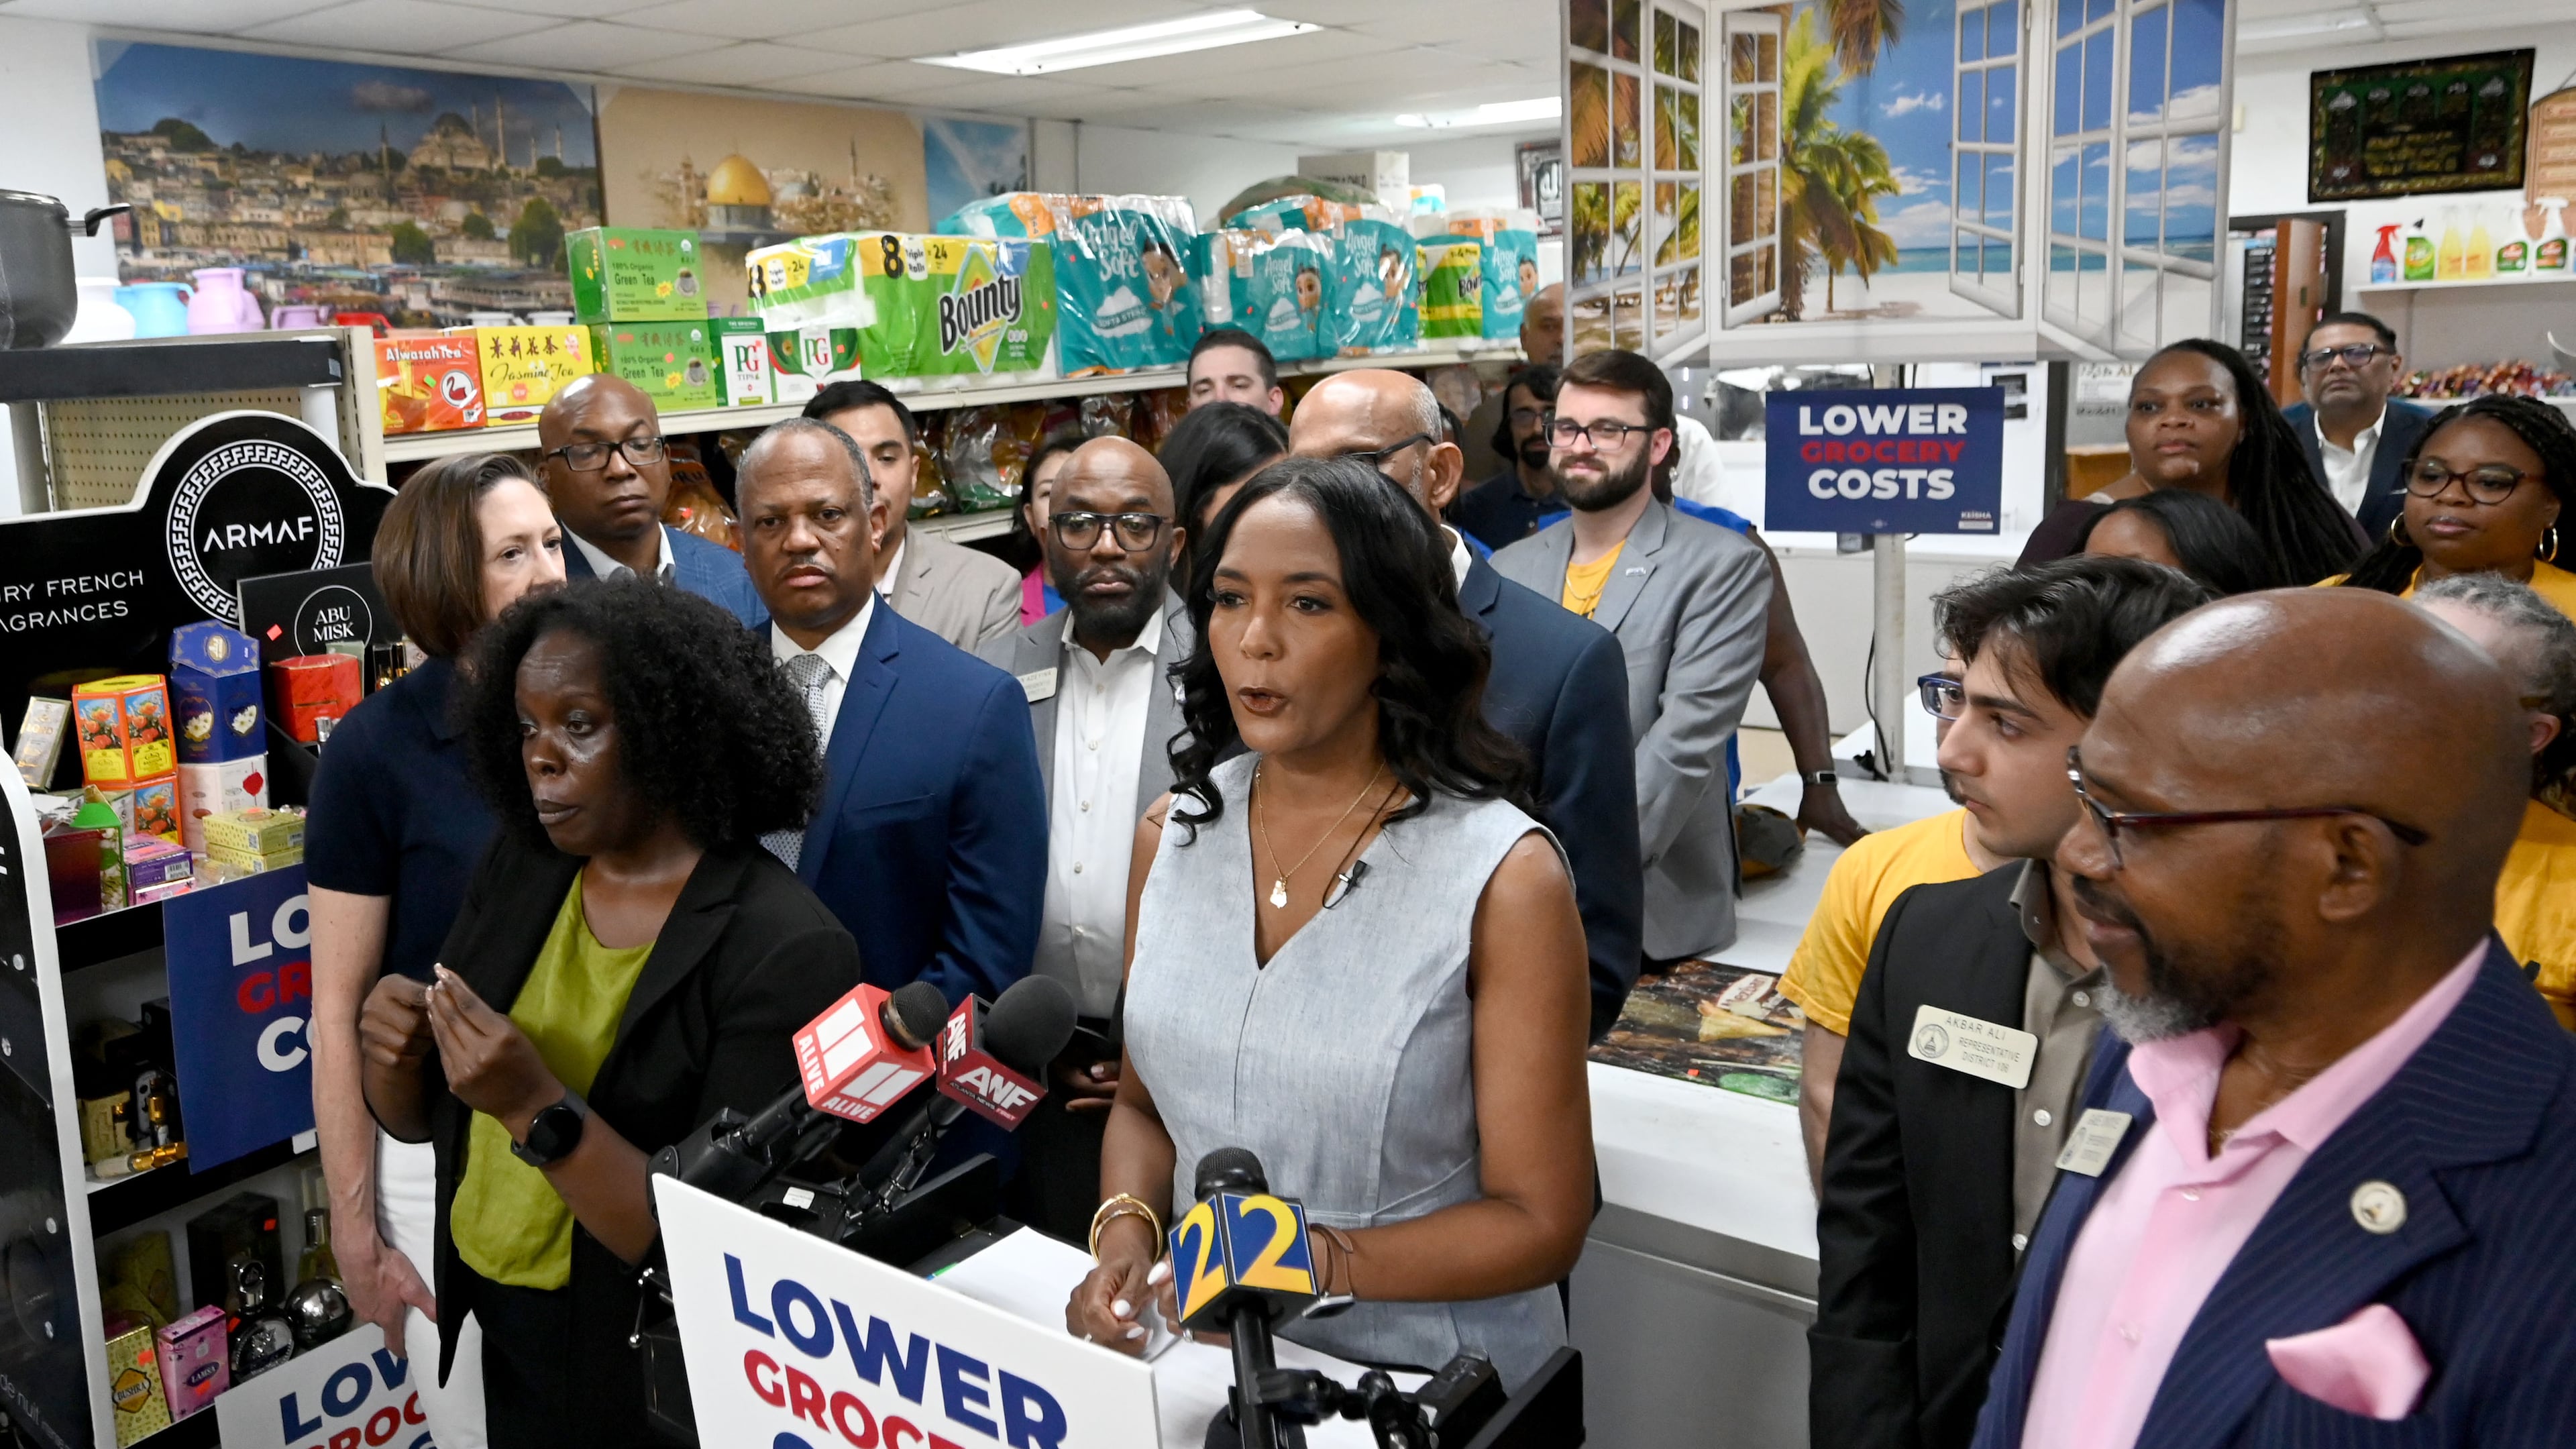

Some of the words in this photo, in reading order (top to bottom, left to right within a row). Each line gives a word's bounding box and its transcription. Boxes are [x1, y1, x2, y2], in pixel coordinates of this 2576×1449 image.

[1081, 219, 1138, 252] Angel
[1345, 229, 1379, 255] Angel
[881, 235, 904, 279] 8
[906, 248, 925, 260] Triple
[932, 244, 948, 260] 24
[1099, 247, 1140, 282] Soft
[1265, 253, 1293, 278] Angel
[1354, 252, 1377, 279] Soft
[614, 272, 638, 286] Green
[642, 273, 655, 286] Tea
[792, 260, 805, 272] 24
[749, 264, 767, 299] 8
[1272, 276, 1293, 295] Soft
[940, 273, 1022, 354] Bounty
[733, 344, 760, 372] PG
[804, 337, 829, 366] PG
[490, 362, 549, 388] Jasmine
[550, 363, 574, 382] Tea
[623, 367, 646, 379] Green
[651, 366, 665, 378] Tea
[1799, 402, 1968, 435] LOWER
[1800, 439, 1966, 464] GROCERY
[1808, 468, 1955, 500] COSTS
[203, 515, 314, 553] ARMAF
[46, 569, 144, 598] FRENCH
[315, 605, 351, 626] ABU
[313, 621, 355, 643] MISK
[947, 1012, 967, 1062] ANF
[1945, 1015, 1984, 1034] AKBAR
[1987, 1027, 2006, 1041] ALI
[257, 1016, 313, 1073] C
[1959, 1036, 2021, 1063] REPRESENTATIVE
[798, 1034, 826, 1095] ALIVE
[1962, 1051, 1996, 1068] DISTRICT
[955, 1065, 1039, 1110] ANF
[821, 1095, 877, 1120] ALIVE
[976, 1095, 996, 1110] NEWS
[996, 1107, 1017, 1121] FIRST
[1237, 1193, 1314, 1295] 2
[1178, 1201, 1228, 1322] 2
[723, 1251, 1067, 1449] LOWER
[117, 1381, 147, 1401] BUSHRA
